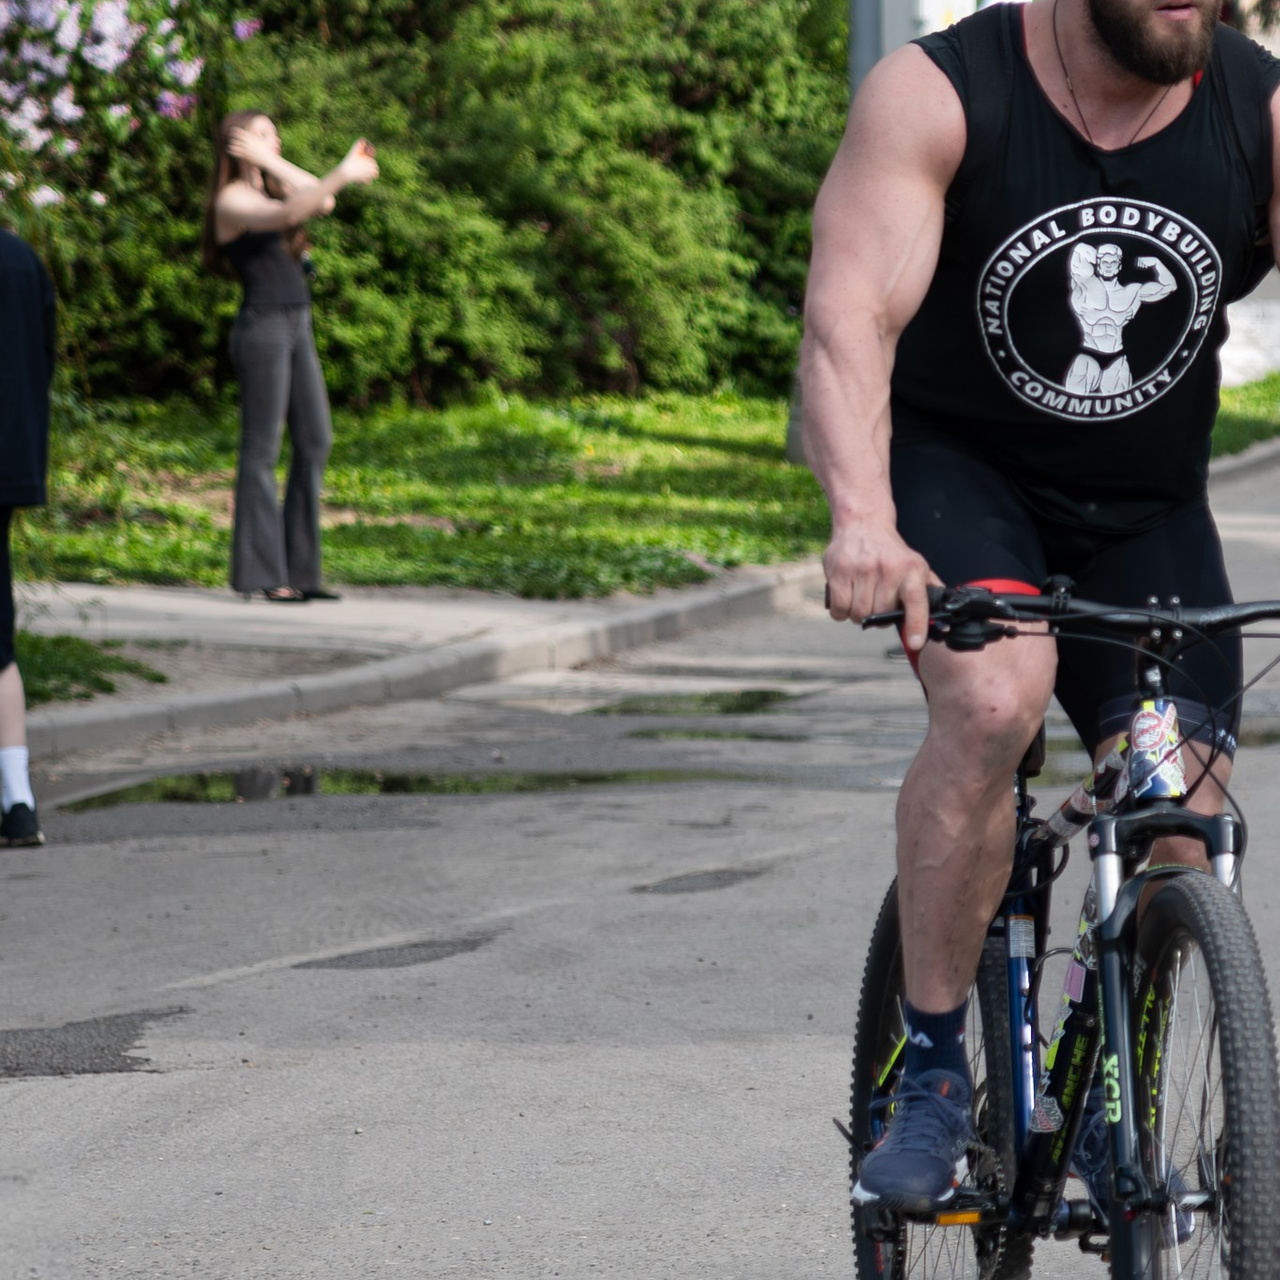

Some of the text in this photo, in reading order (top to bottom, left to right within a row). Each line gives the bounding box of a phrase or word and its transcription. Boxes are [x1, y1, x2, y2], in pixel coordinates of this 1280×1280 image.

[984, 205, 1217, 335] NATIONAL BODYBUILDING
[1010, 368, 1173, 415] COMMUNITY
[1103, 1052, 1122, 1124] XCR
